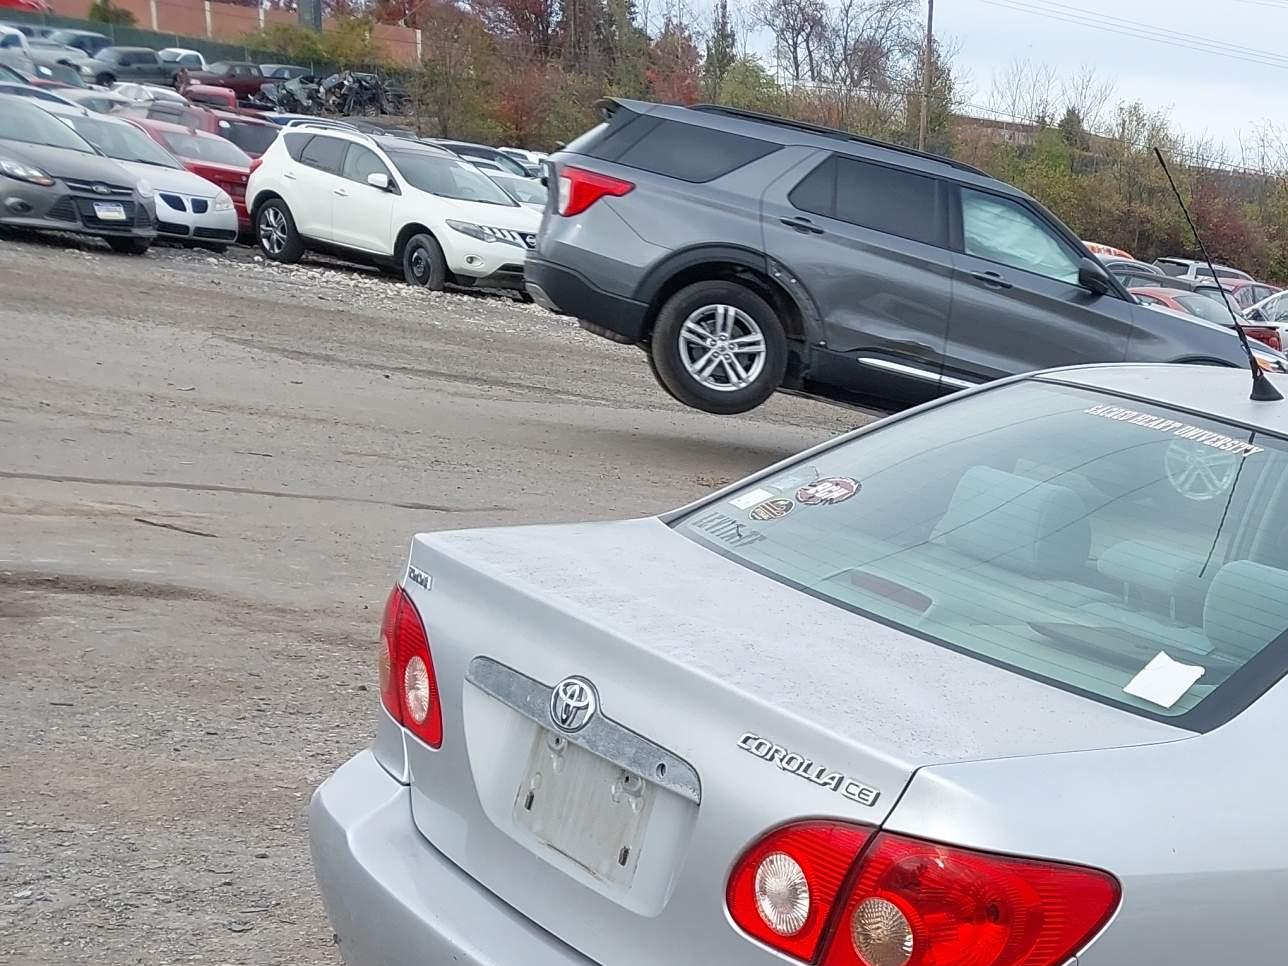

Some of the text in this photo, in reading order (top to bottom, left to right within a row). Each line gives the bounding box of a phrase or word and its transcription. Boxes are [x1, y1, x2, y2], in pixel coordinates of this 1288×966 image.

[1083, 404, 1265, 457] SACRED HEART UNIVERSITY
[737, 732, 878, 805] COROLLA CE
